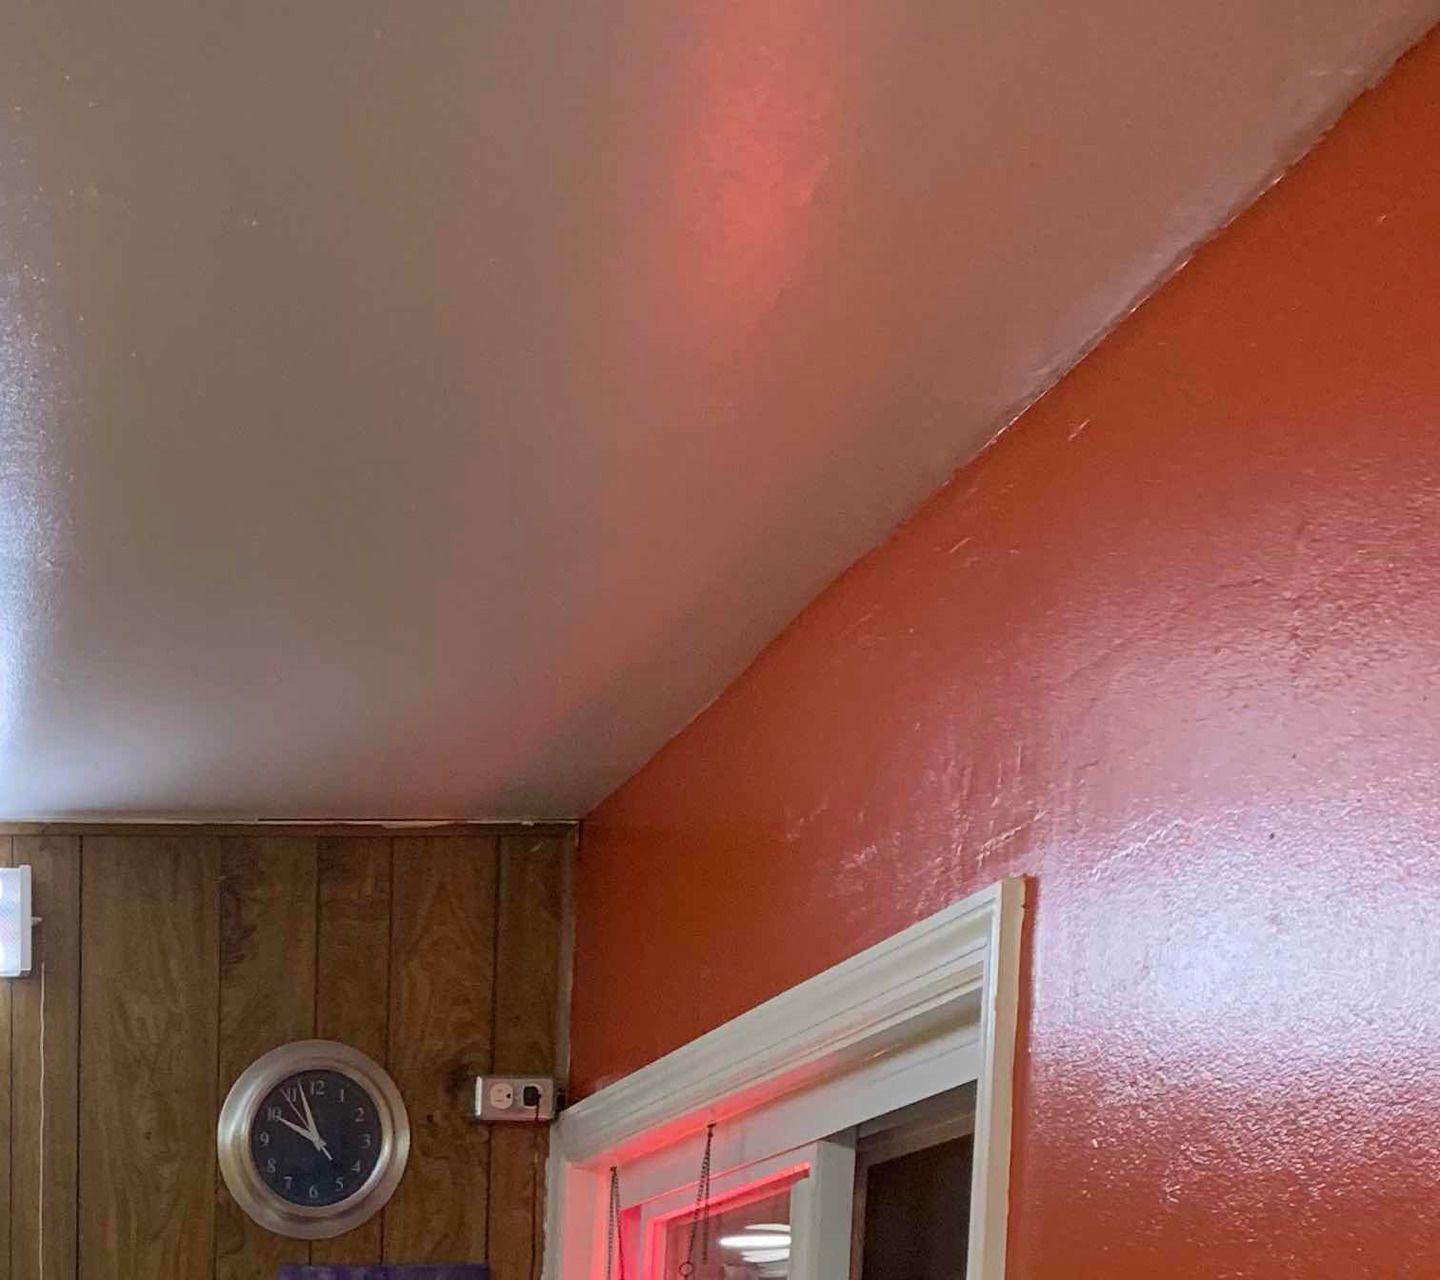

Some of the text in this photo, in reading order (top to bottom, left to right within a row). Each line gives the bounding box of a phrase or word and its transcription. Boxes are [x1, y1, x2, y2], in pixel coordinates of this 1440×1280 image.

[309, 1080, 326, 1095] 12
[338, 1088, 345, 1103] 1
[266, 1107, 282, 1121] 10
[354, 1107, 365, 1122] 2
[259, 1133, 270, 1148] 9
[360, 1134, 371, 1149] 3
[266, 1158, 277, 1174] 8
[351, 1161, 362, 1174] 4
[283, 1176, 293, 1191] 7
[335, 1177, 345, 1192] 5
[308, 1184, 319, 1199] 6
